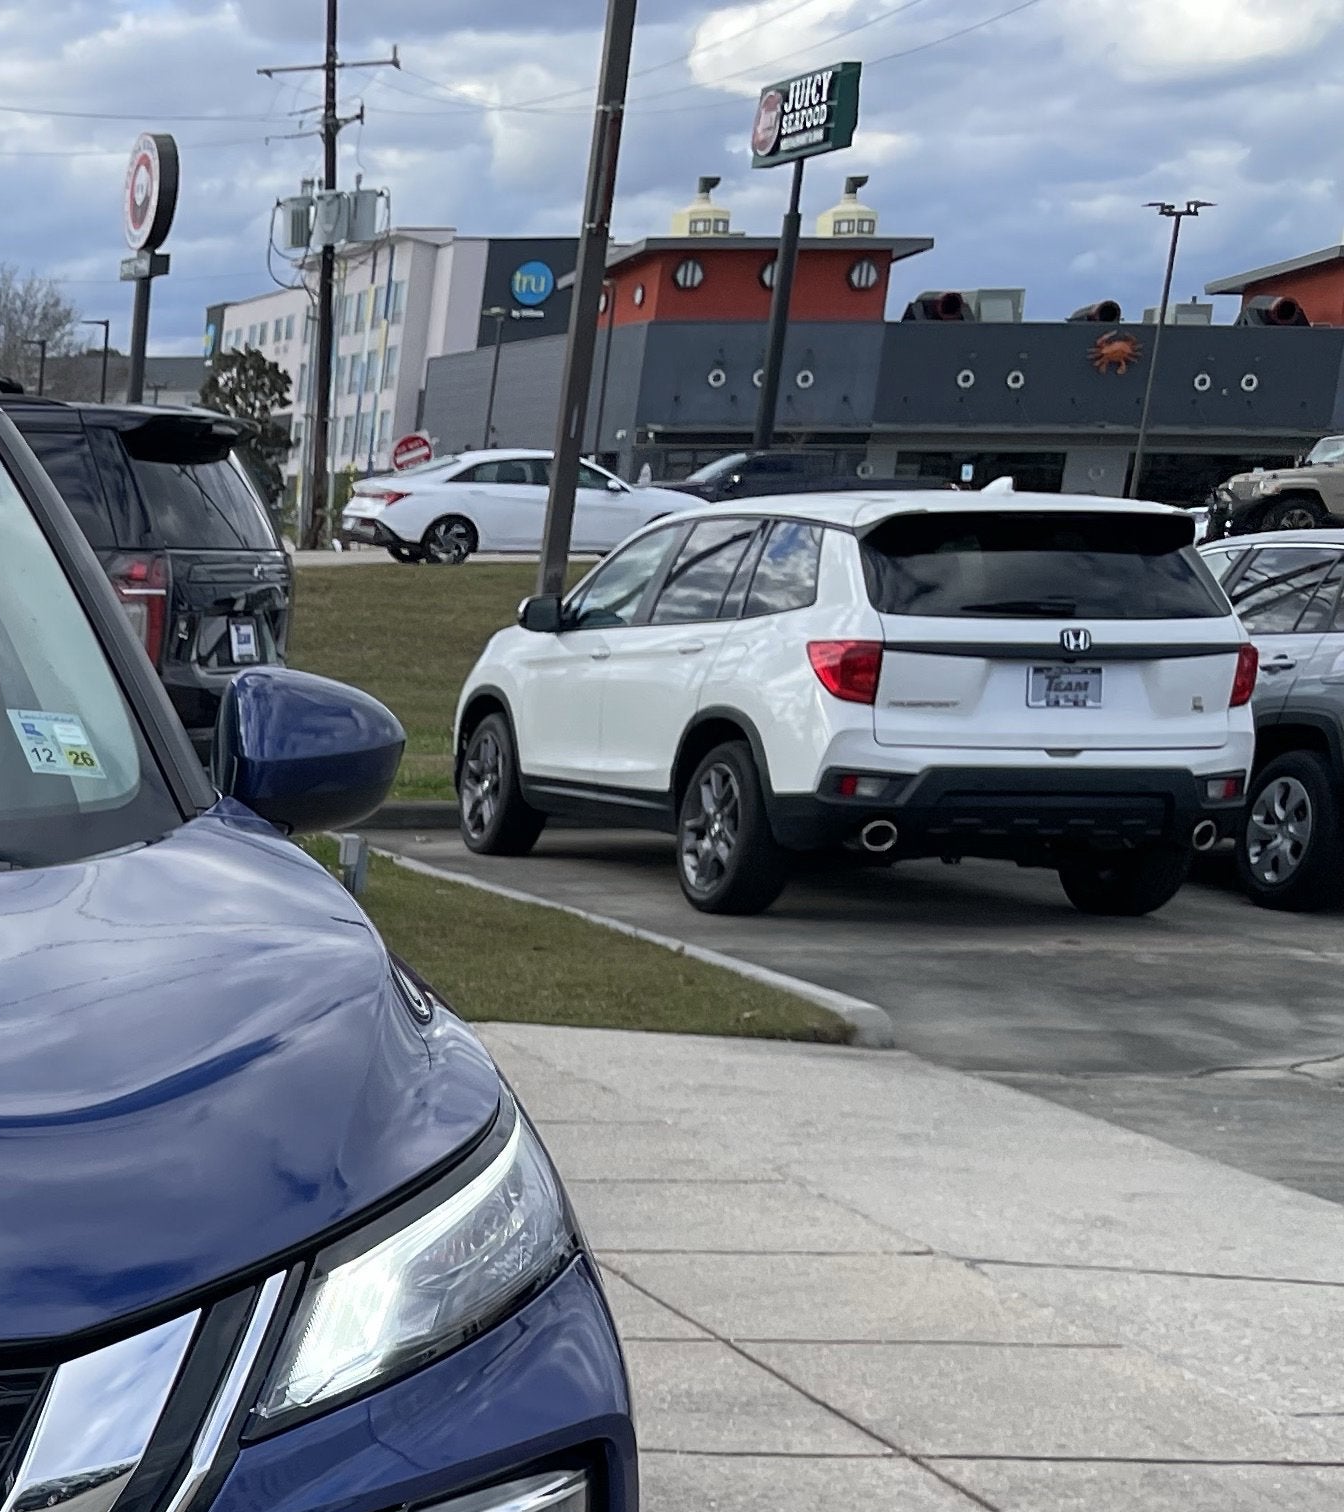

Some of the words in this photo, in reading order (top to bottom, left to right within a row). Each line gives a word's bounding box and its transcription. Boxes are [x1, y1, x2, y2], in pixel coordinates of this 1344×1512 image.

[783, 71, 832, 113] JUICY
[780, 103, 827, 135] SEAFOOD
[514, 271, 545, 294] tru
[31, 747, 57, 763] 12
[69, 750, 95, 767] 26
